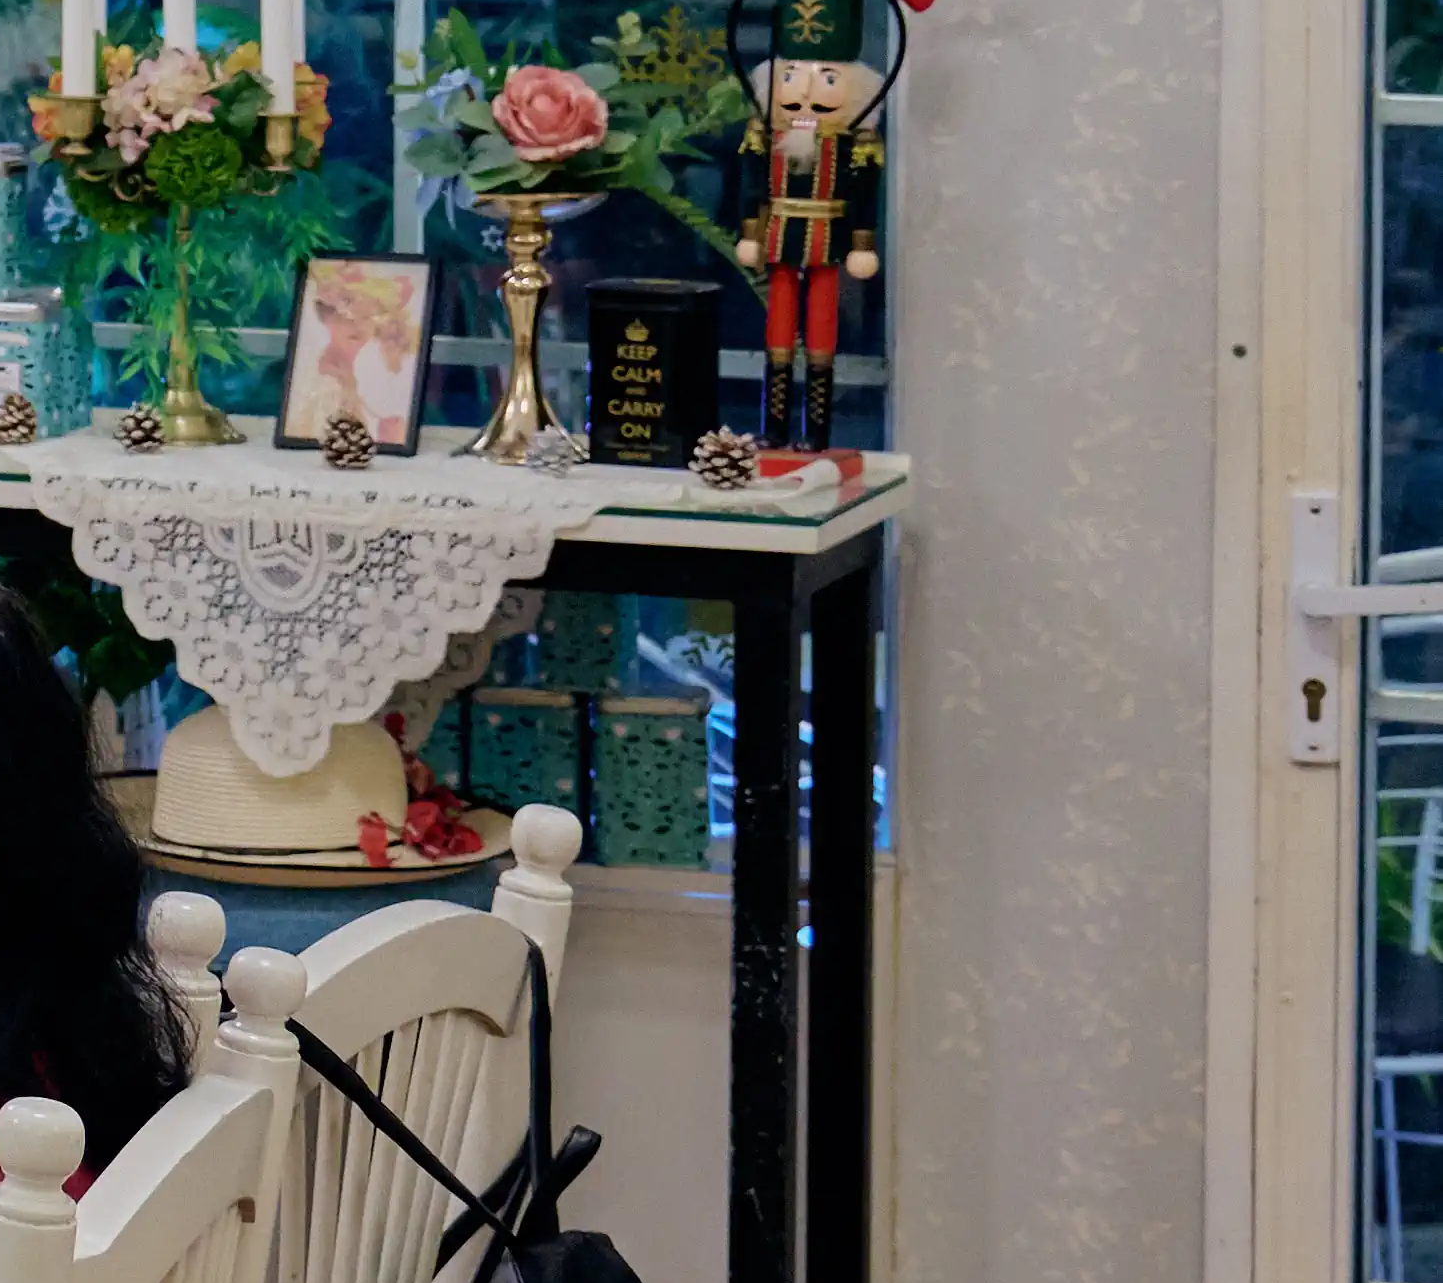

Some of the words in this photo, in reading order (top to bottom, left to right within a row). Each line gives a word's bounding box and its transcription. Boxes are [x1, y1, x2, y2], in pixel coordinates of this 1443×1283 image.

[616, 344, 659, 361] KEEP
[611, 365, 662, 384] CALM
[607, 398, 665, 418] CARRY
[620, 421, 651, 439] ON
